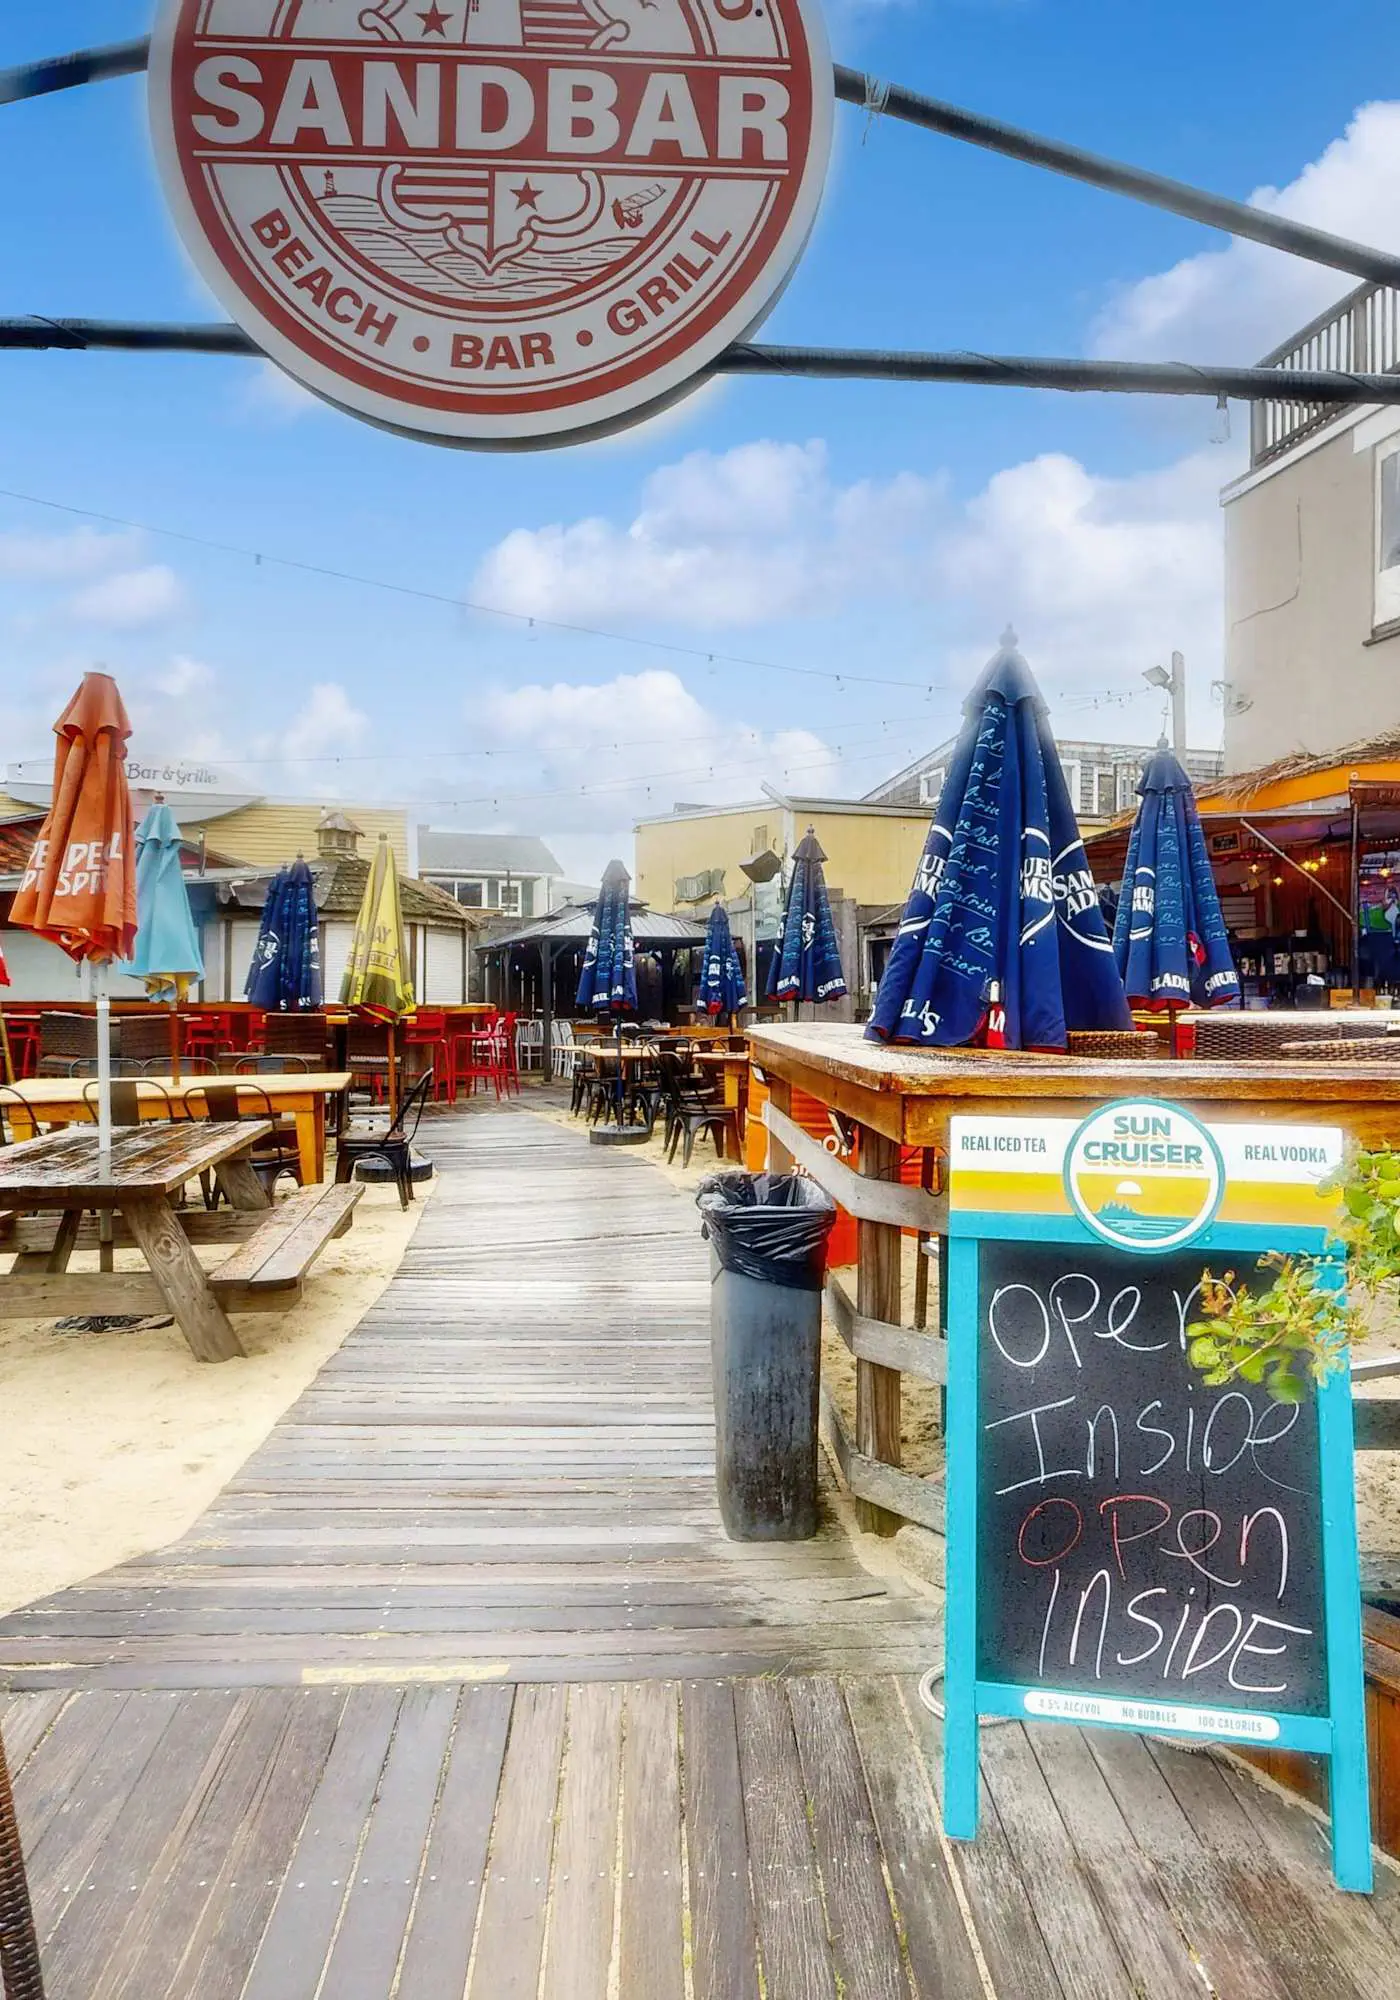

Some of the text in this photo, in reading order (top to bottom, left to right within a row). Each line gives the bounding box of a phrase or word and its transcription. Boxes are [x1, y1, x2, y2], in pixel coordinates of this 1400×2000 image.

[190, 54, 792, 162] SANDBAR
[250, 208, 734, 372] BEACH BAR GRILL
[127, 763, 158, 780] Bar
[162, 768, 175, 781] &
[1114, 1115, 1171, 1138] SUN
[961, 1136, 1047, 1153] REAL ICED TEA
[1083, 1141, 1204, 1165] CRUISER
[1244, 1145, 1327, 1163] REAL VODKA
[1121, 1707, 1134, 1718] NO
[1138, 1709, 1177, 1724] BUBBLES
[1218, 1717, 1263, 1733] CALORIES
